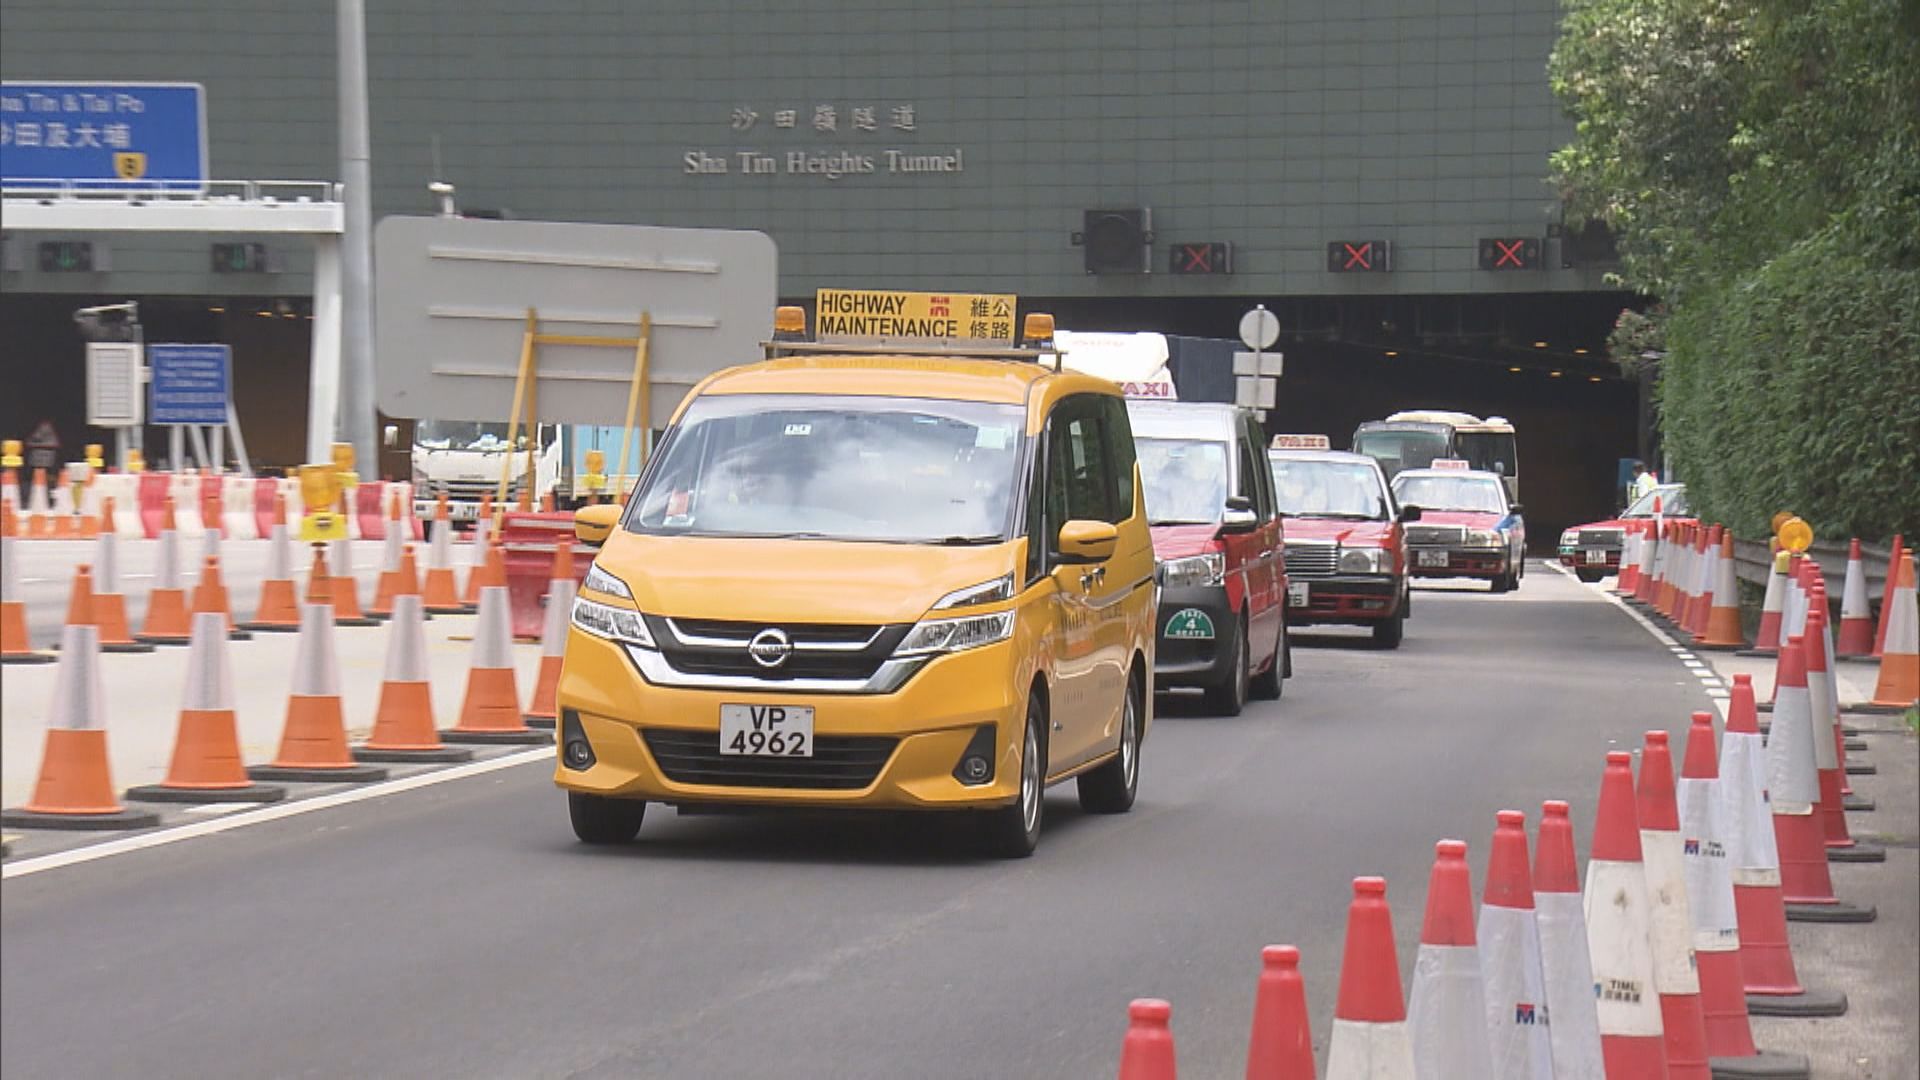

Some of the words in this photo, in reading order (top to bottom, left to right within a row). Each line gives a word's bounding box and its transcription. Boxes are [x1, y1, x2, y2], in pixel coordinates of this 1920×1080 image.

[26, 92, 59, 112] Tin
[114, 93, 145, 113] Po
[684, 151, 727, 173] Sha
[736, 152, 777, 173] Tin
[787, 151, 874, 179] Heights
[884, 149, 963, 172] Tunnel
[820, 293, 906, 315] HIGHWAY
[819, 316, 958, 338] MAINTENANCE
[1185, 618, 1196, 629] 4
[750, 705, 786, 731] VP
[728, 729, 805, 756] 4962
